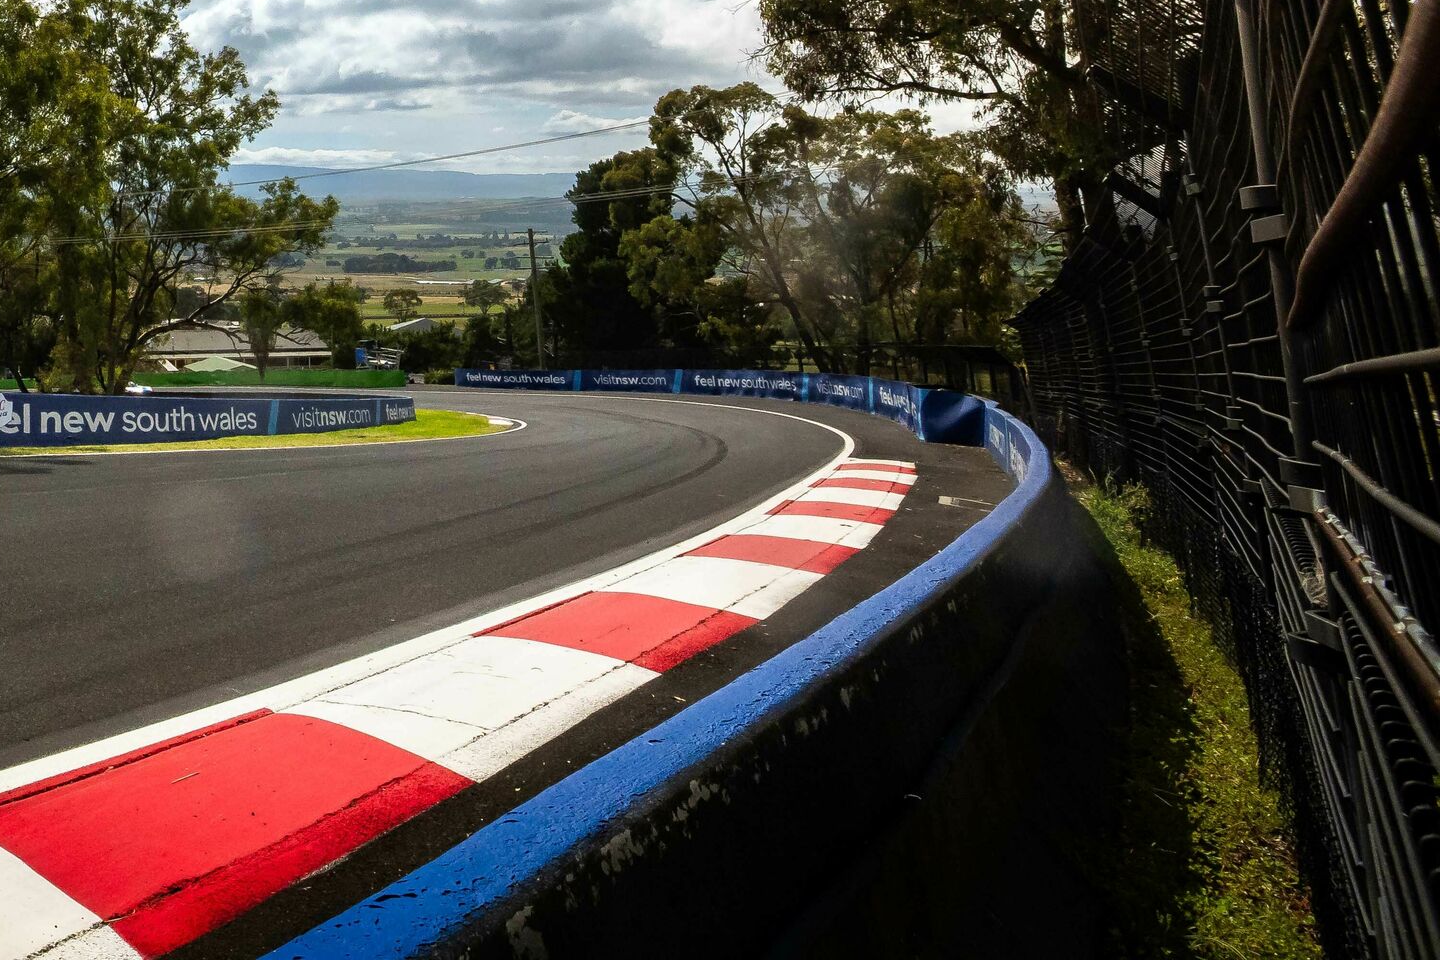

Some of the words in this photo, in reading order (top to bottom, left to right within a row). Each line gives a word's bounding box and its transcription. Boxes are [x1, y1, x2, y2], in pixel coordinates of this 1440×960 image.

[466, 372, 481, 382] feel
[482, 374, 502, 382] new
[503, 374, 532, 384] south
[532, 373, 566, 385] wales
[593, 373, 667, 386] visitnsw.com
[694, 375, 716, 388] feel
[717, 378, 740, 388] new
[741, 377, 770, 390] south
[771, 379, 797, 391] wales
[40, 411, 115, 434] new
[122, 406, 193, 433] south
[198, 406, 257, 431] wales
[292, 406, 371, 429] visitnsw.com
